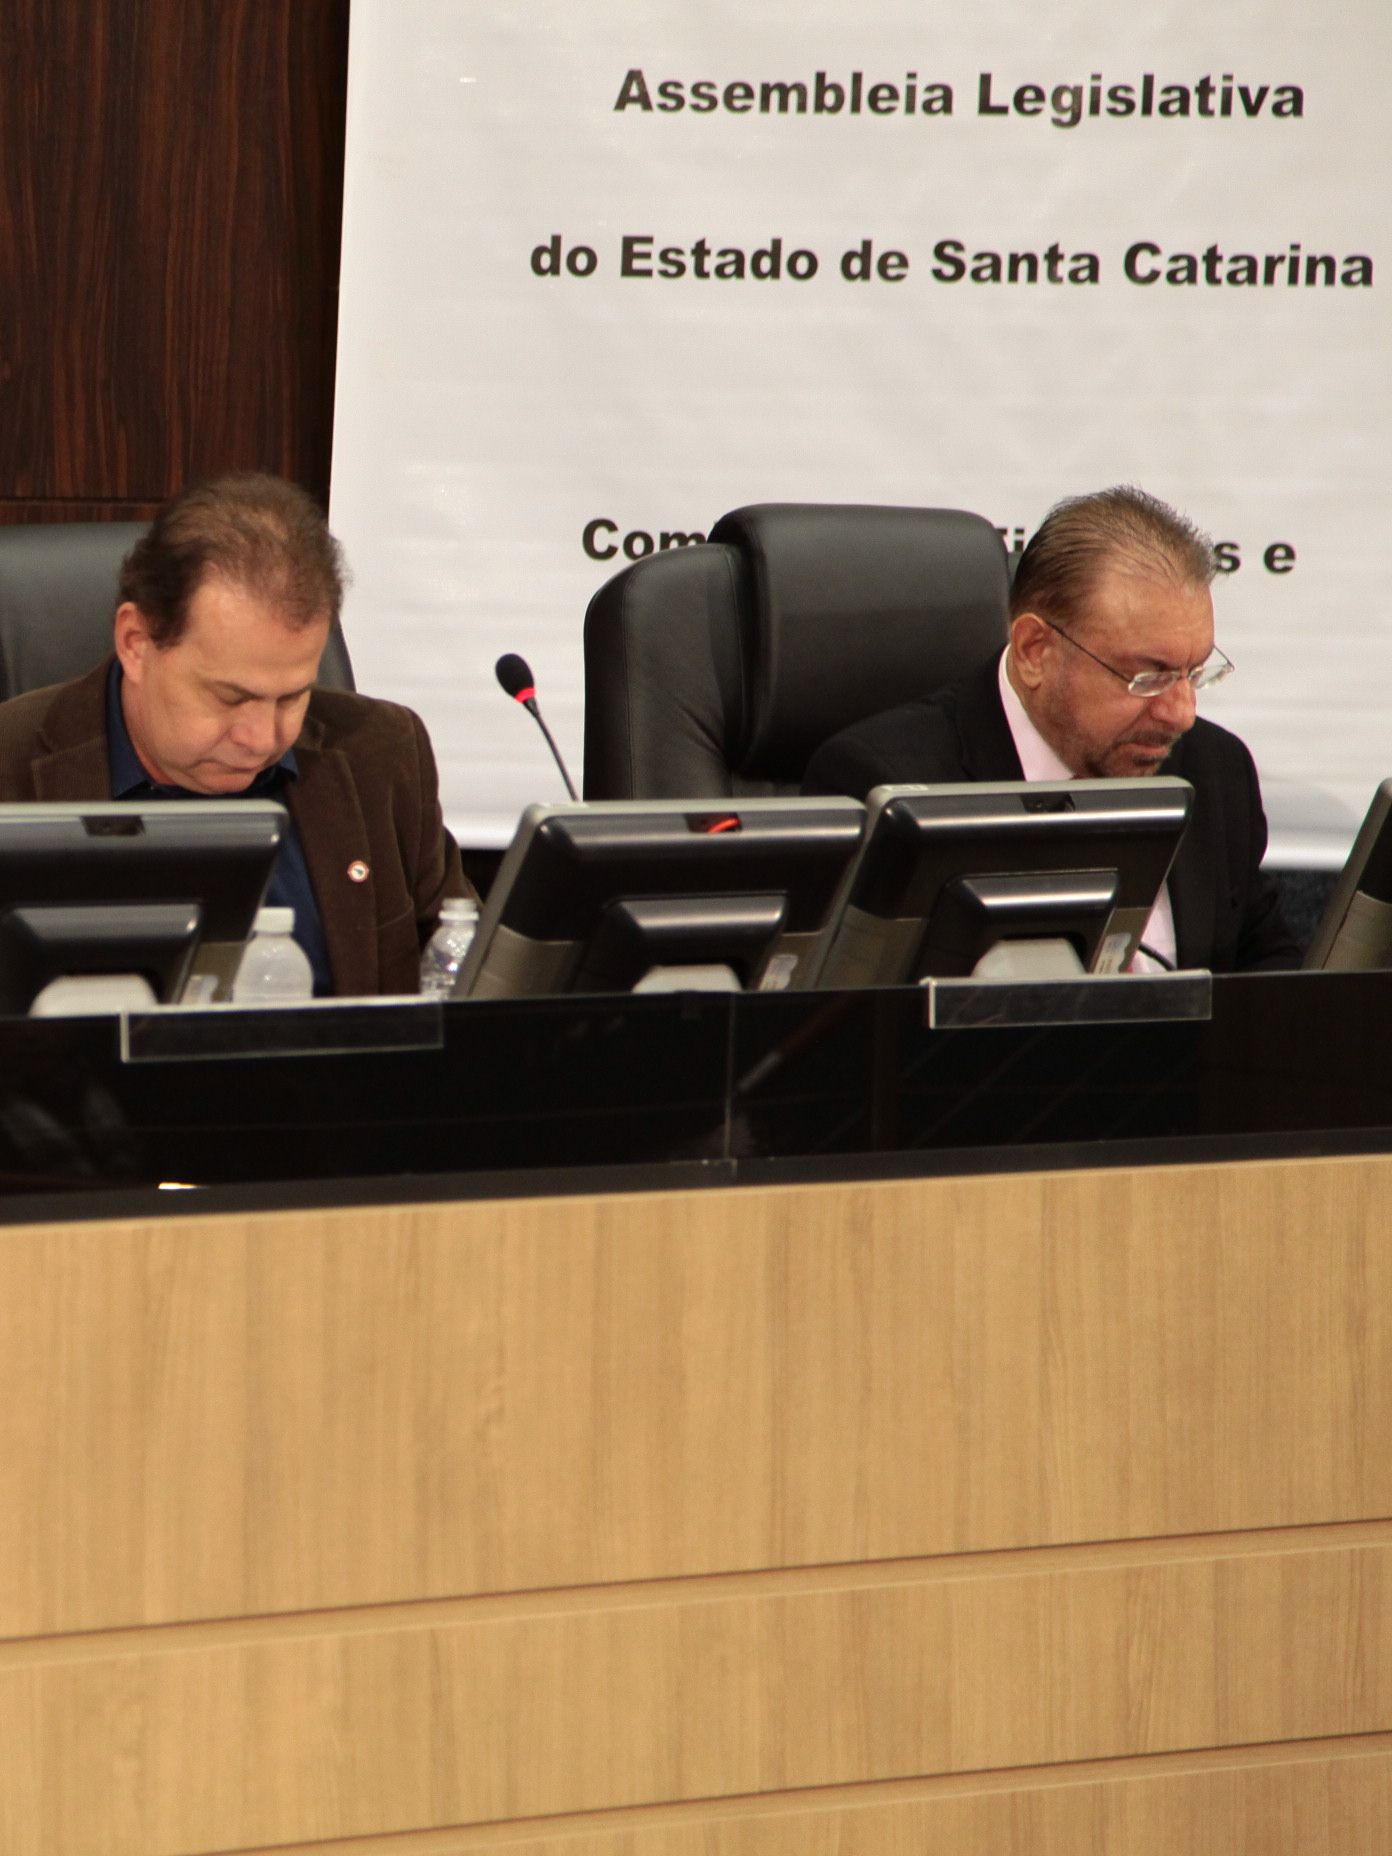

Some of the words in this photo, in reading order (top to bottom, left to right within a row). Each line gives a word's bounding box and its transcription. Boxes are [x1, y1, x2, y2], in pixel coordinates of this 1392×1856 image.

[613, 69, 954, 116] Assembleia
[977, 72, 1305, 129] Legislativa
[529, 234, 599, 278] do
[620, 235, 819, 281] Estado
[840, 239, 910, 283] de
[931, 239, 1101, 285] Santa
[1123, 241, 1374, 288] Catarina
[1262, 542, 1297, 575] e
